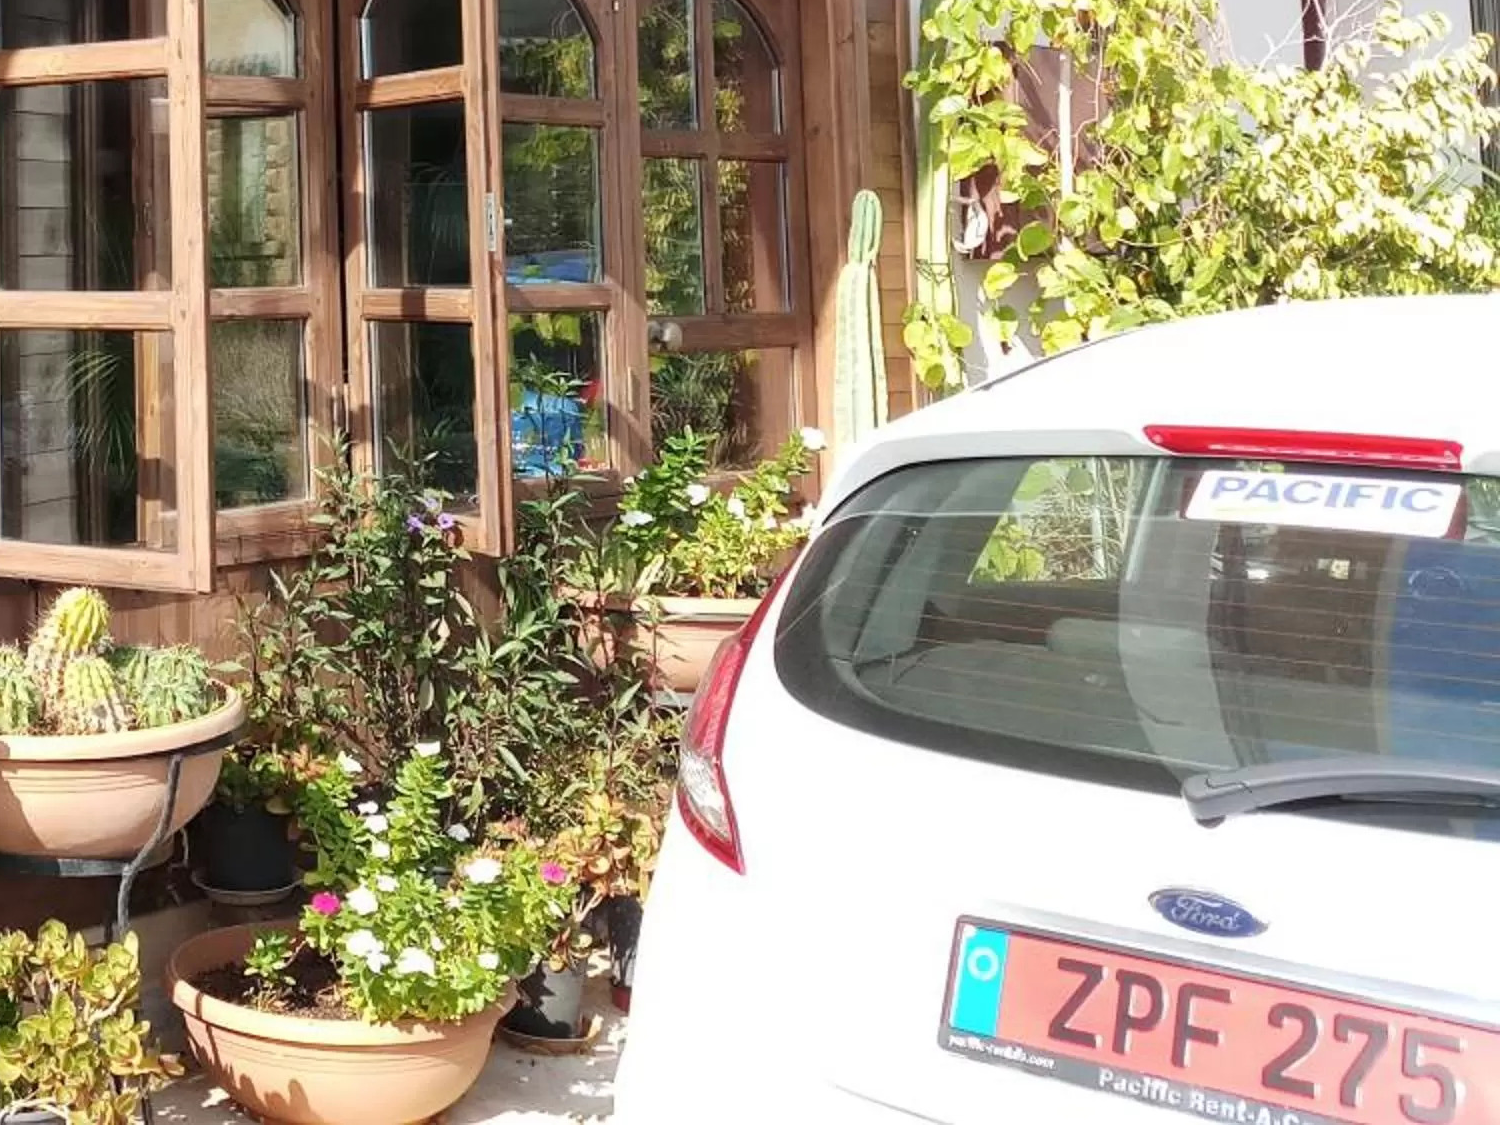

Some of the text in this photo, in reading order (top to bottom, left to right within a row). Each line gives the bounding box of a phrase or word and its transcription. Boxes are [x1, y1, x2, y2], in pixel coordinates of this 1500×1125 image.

[1211, 476, 1443, 512] PACIFIC
[1171, 897, 1240, 933] Ford
[1048, 957, 1463, 1124] ZPF 275
[1099, 1066, 1182, 1106] Pacific
